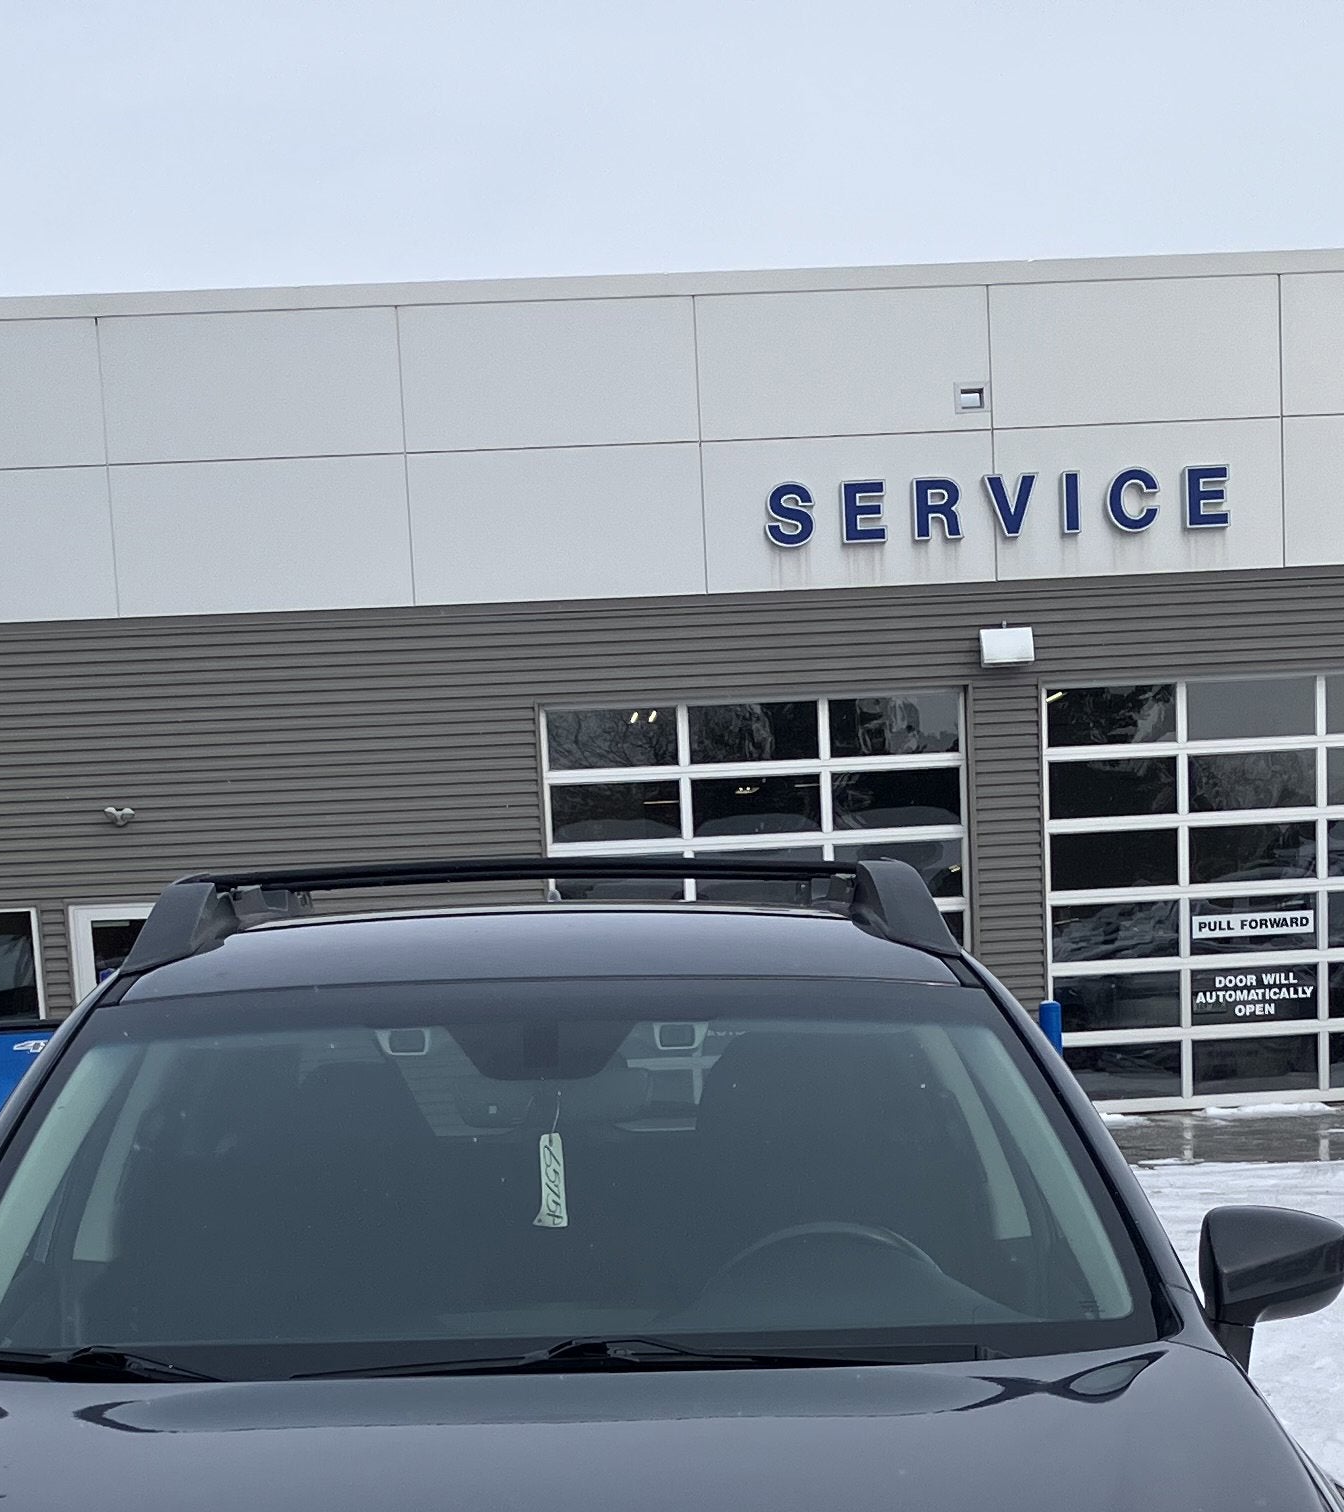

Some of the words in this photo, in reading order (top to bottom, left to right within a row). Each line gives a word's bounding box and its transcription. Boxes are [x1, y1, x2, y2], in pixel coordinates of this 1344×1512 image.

[764, 464, 1232, 549] SERVICE
[1198, 920, 1235, 932] PULL
[1240, 916, 1309, 930] FORWARD
[1215, 975, 1256, 988] DOOR
[1262, 972, 1298, 985] WILL
[1196, 986, 1314, 1004] AUTOMATICALLY
[1234, 1003, 1276, 1016] OPEN
